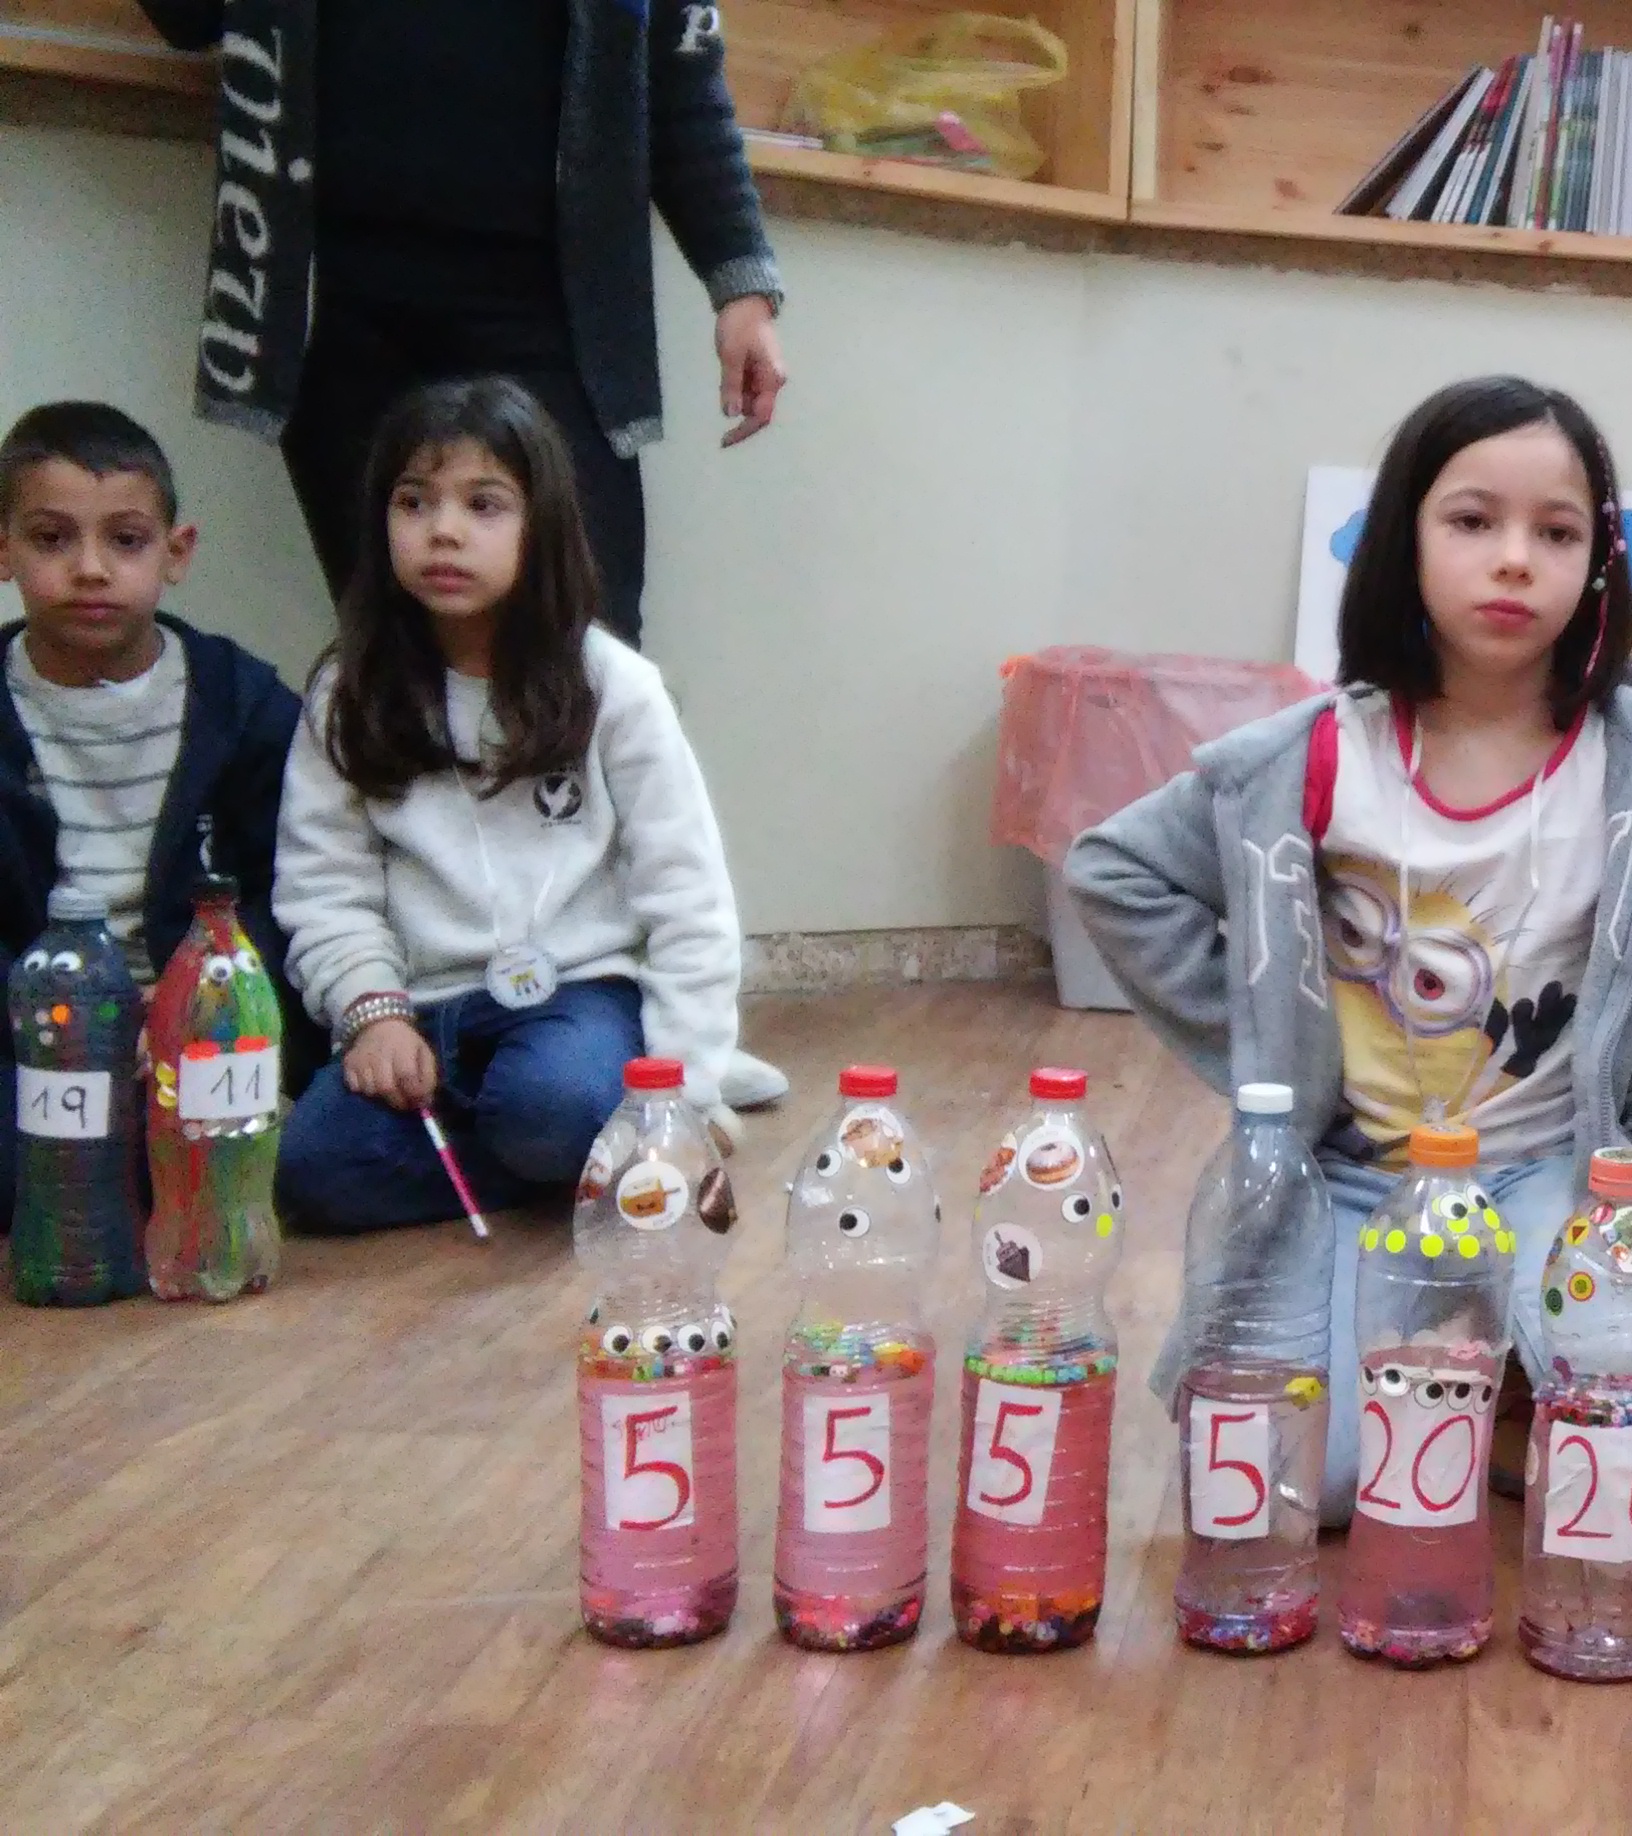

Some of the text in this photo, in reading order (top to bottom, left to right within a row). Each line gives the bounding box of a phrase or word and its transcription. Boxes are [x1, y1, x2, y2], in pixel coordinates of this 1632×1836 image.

[31, 1085, 87, 1130] 19
[210, 1063, 262, 1106] 11
[619, 1406, 692, 1532] 5
[821, 1406, 886, 1510] 5
[979, 1402, 1044, 1507] 5
[1209, 1412, 1266, 1526] 5
[1360, 1400, 1476, 1512] 20
